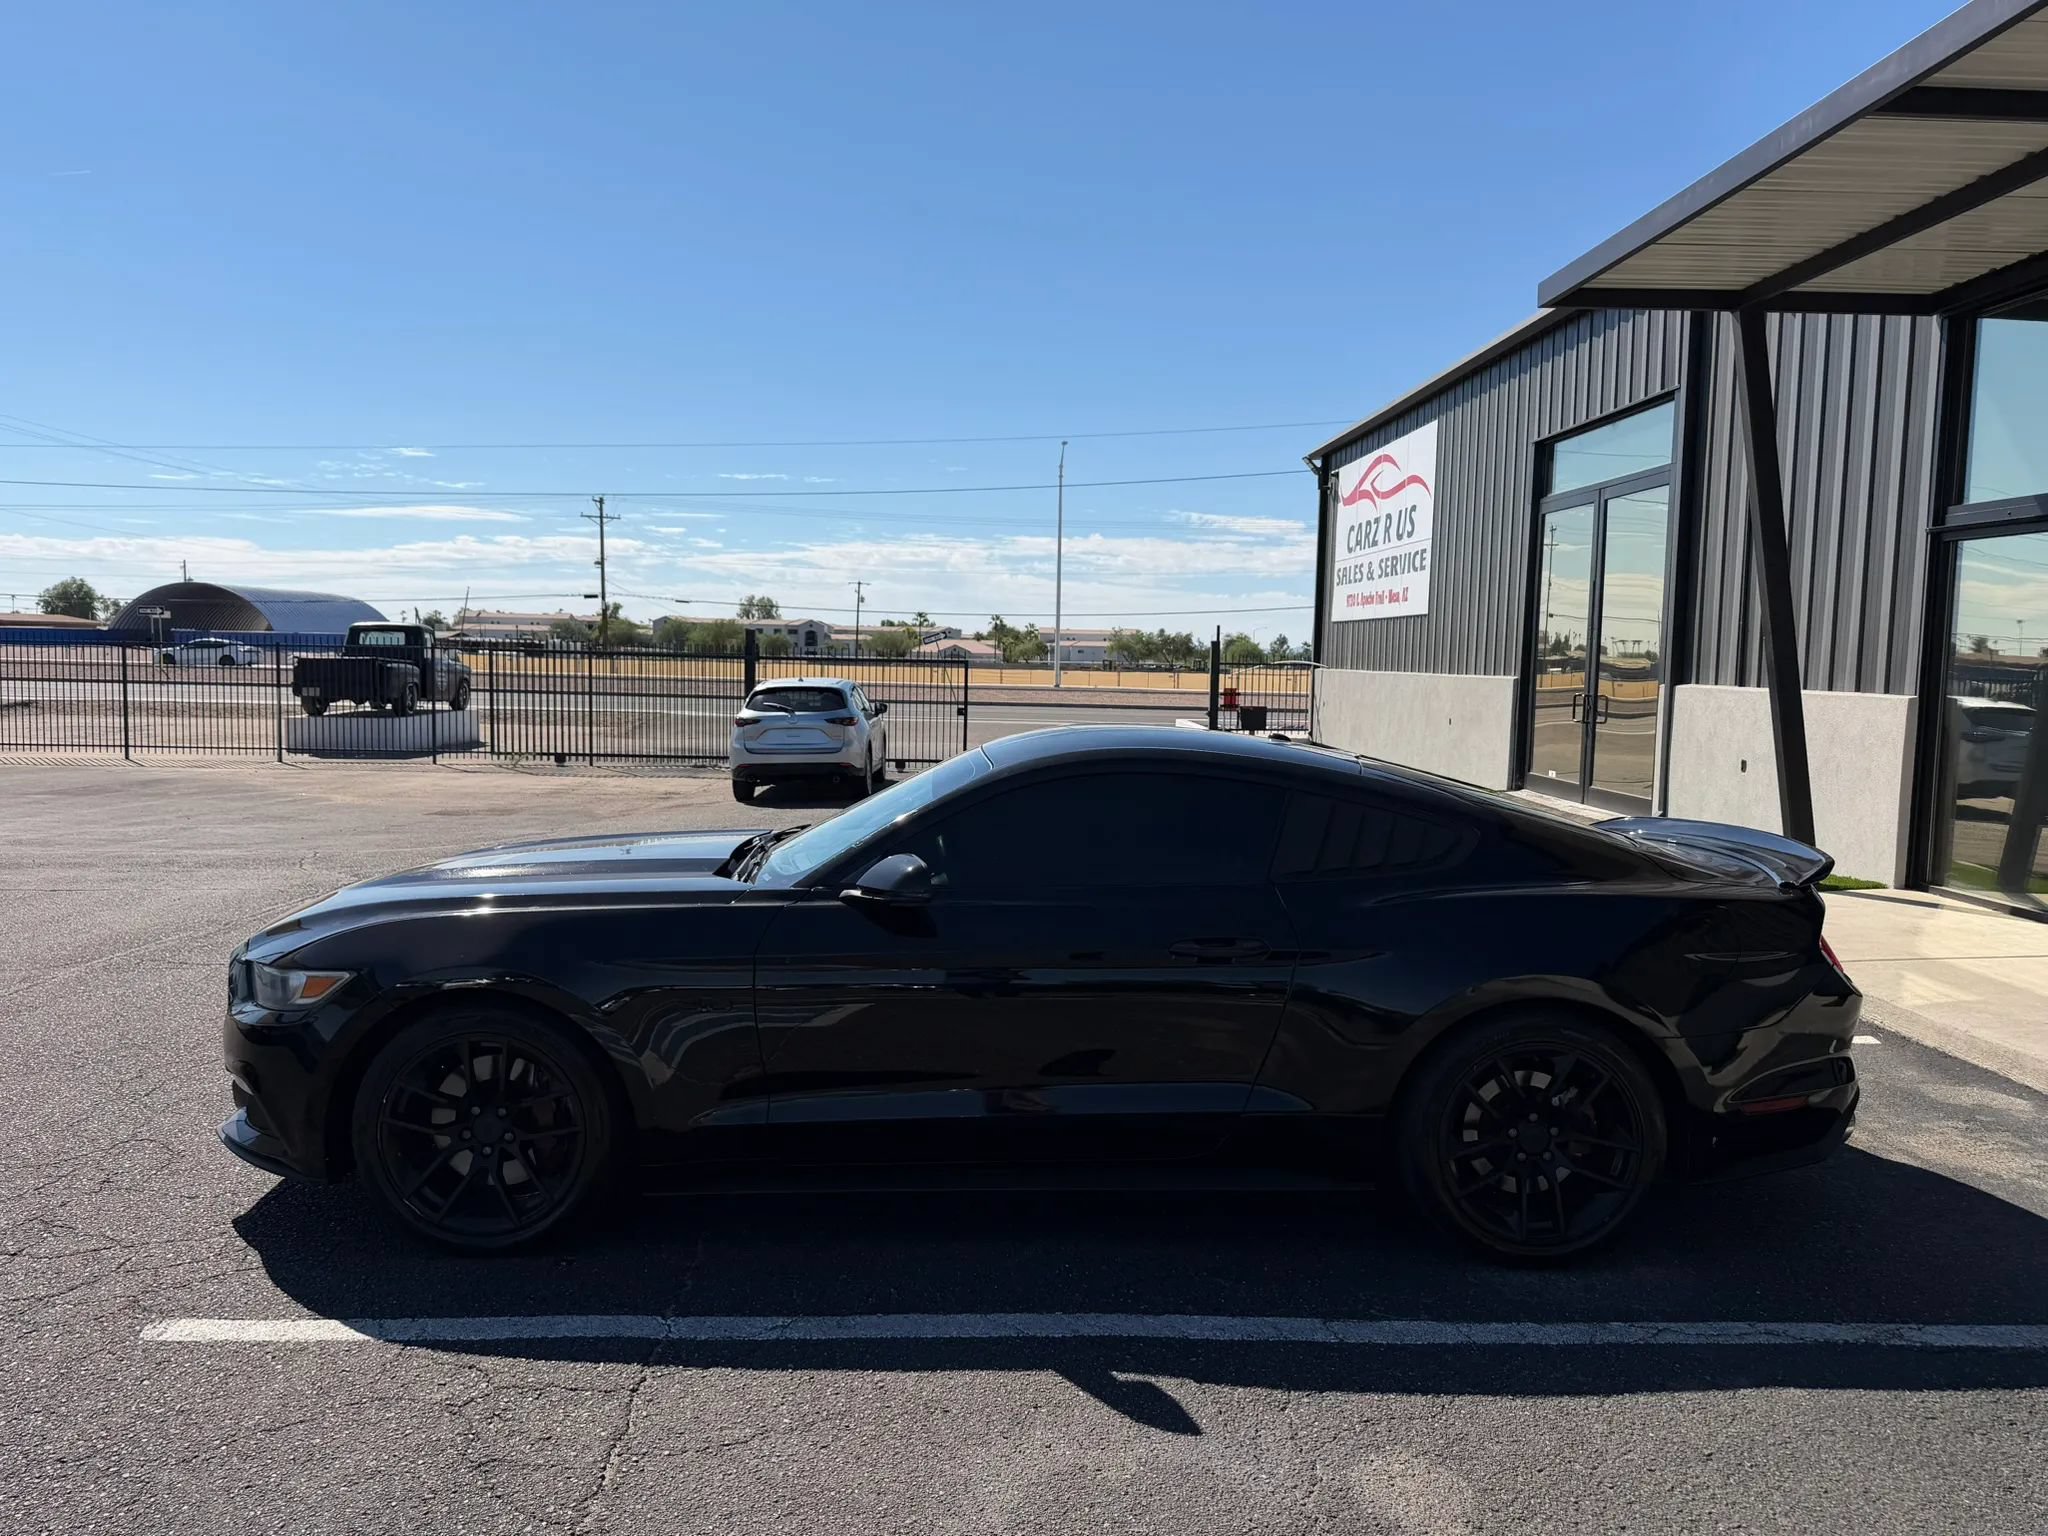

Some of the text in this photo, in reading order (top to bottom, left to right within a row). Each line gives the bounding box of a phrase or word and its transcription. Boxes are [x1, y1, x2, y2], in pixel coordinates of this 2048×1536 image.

[1347, 504, 1417, 554] CARZ R US
[1336, 548, 1427, 587] SALES & SERVICE
